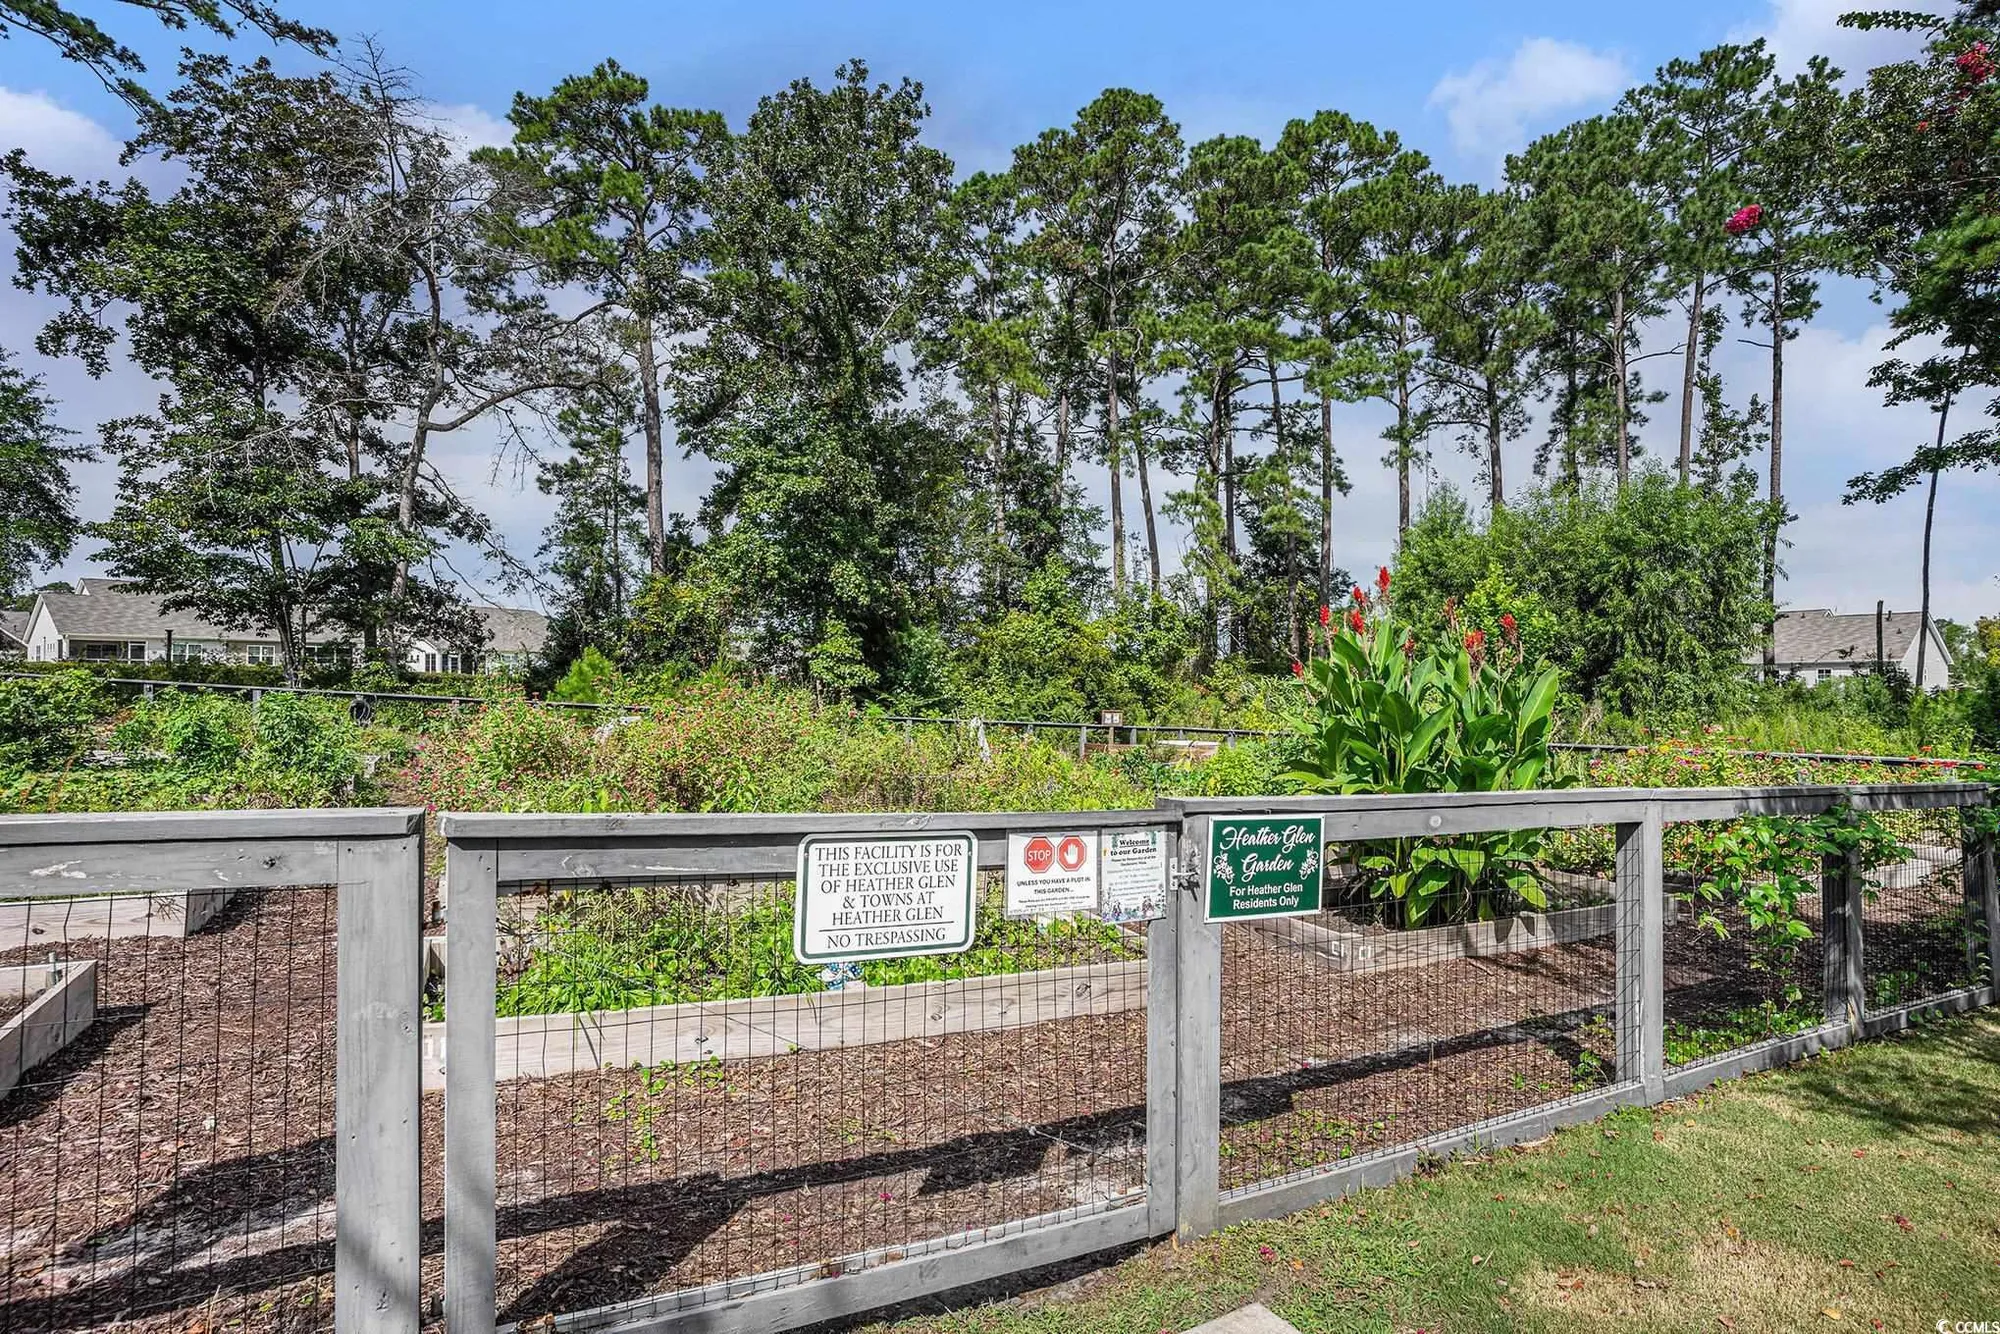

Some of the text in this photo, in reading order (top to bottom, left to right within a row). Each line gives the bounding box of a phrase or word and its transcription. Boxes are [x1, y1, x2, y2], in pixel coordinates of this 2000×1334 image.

[1220, 825, 1316, 853] Heather Glen
[816, 844, 962, 861] THIS FACILITY IS FOR
[1028, 850, 1051, 861] STOP
[819, 860, 958, 877] THE EXCLUSIVE USE
[1241, 853, 1294, 882] Garden
[821, 874, 956, 894] OF HEATHER GLEN
[1229, 882, 1303, 896] For Heather Glen
[842, 891, 935, 909] & TOWNS AT
[1233, 896, 1299, 910] Residents Only
[832, 906, 944, 926] HEATHER GLEN
[828, 928, 946, 949] NO TRESPASSING
